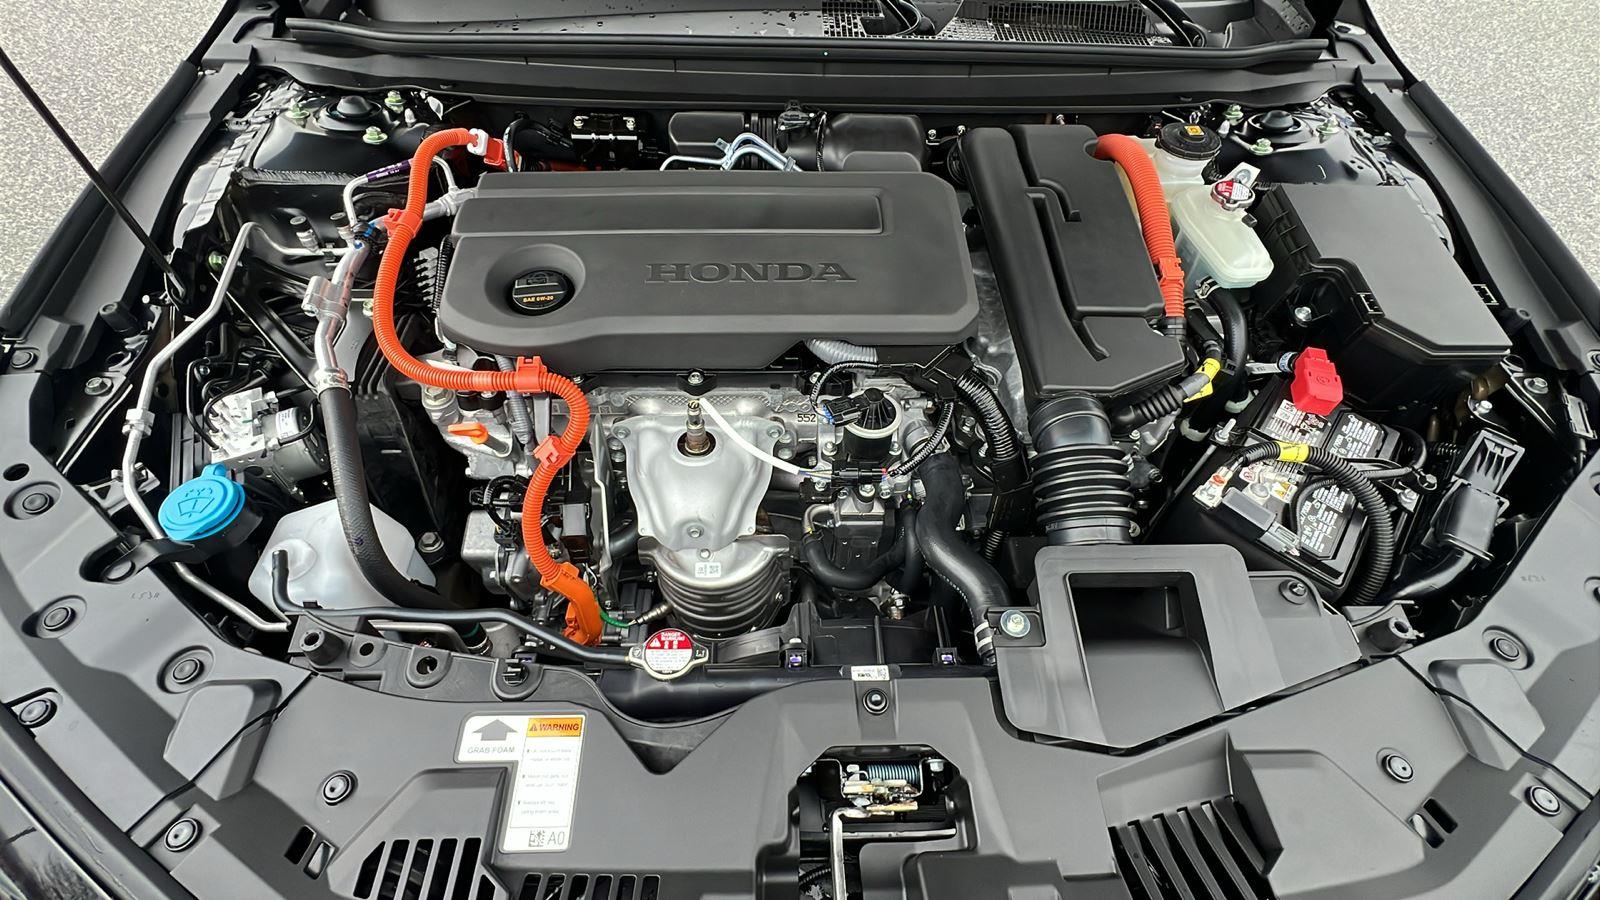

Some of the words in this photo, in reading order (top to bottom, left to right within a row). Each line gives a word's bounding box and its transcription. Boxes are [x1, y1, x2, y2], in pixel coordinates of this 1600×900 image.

[644, 262, 857, 284] HONDA
[797, 413, 817, 423] 552
[539, 723, 580, 732] WARNING
[467, 746, 491, 754] GRAB
[547, 831, 565, 846] A0
